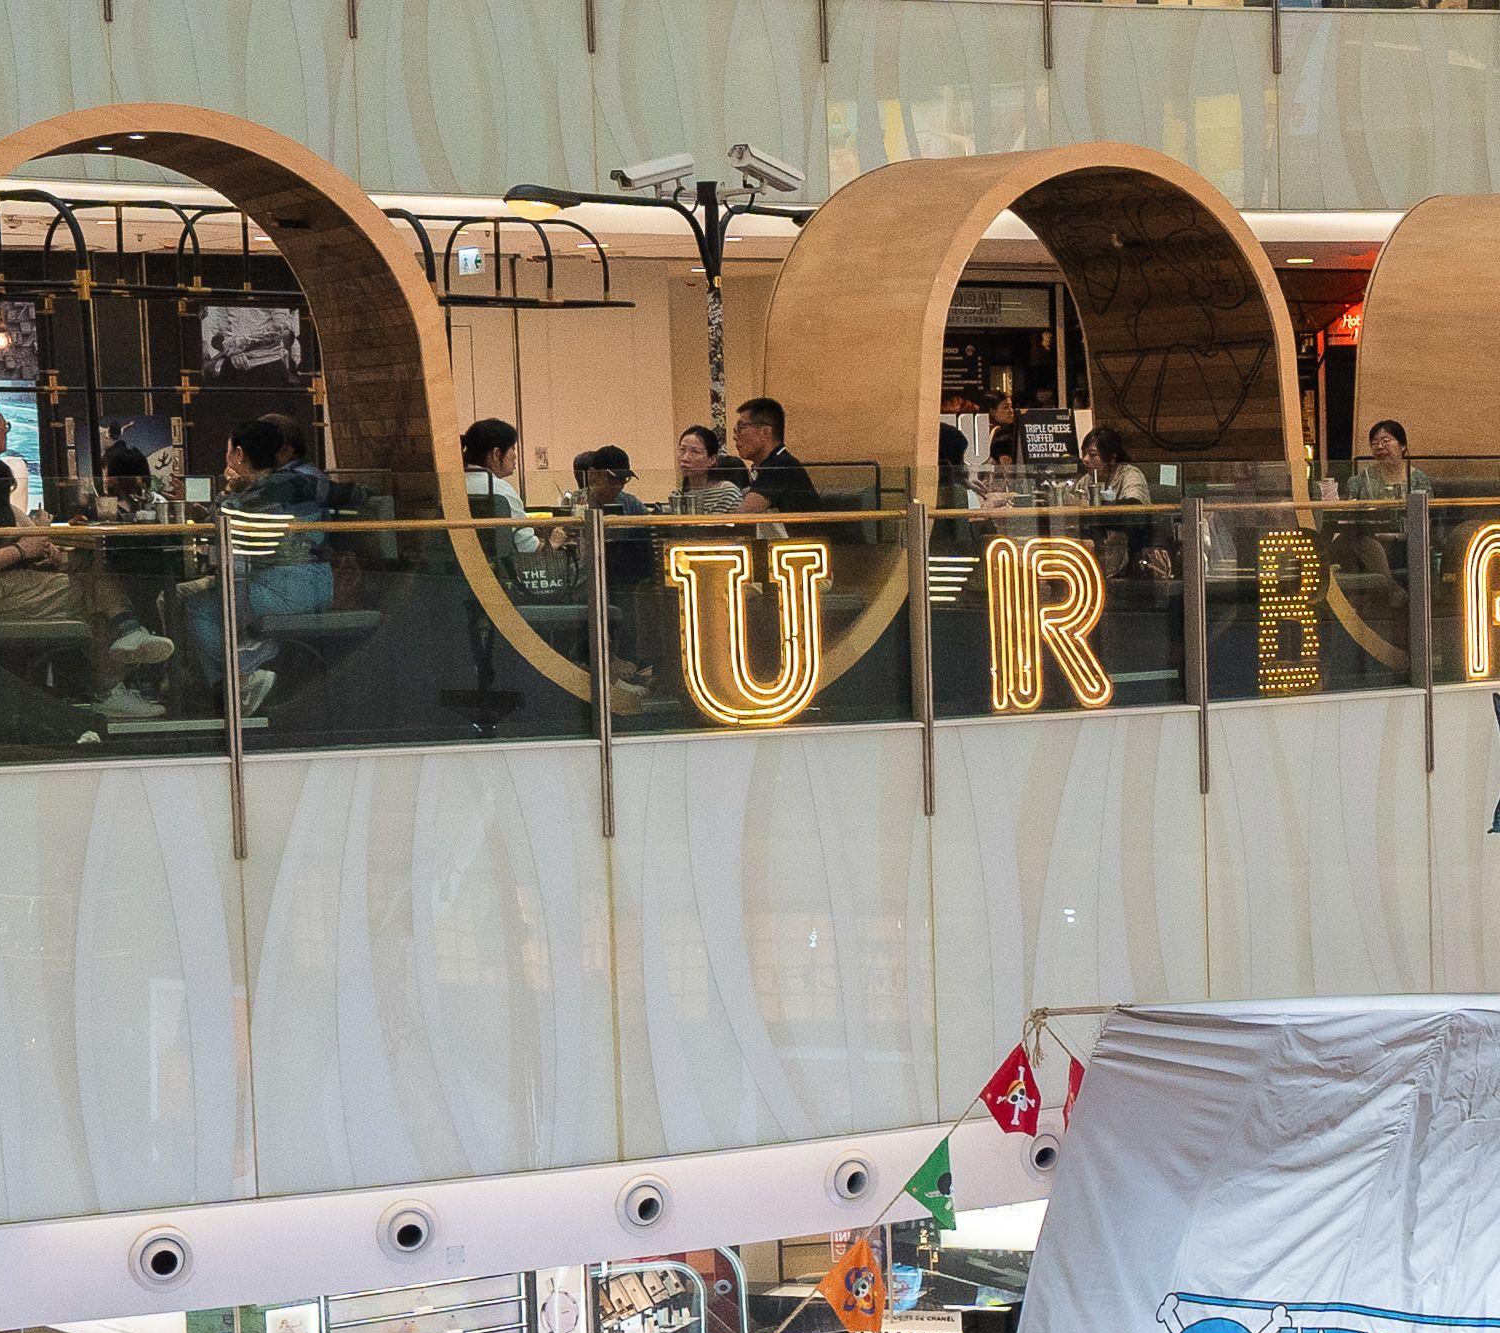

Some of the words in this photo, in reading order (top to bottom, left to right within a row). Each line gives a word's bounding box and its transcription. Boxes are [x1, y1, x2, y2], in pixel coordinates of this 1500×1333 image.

[1025, 424, 1047, 433] TRIPLE
[1048, 424, 1071, 433] CHEESE
[1026, 434, 1054, 443] STUFFED
[1028, 443, 1049, 452] CRUST
[1050, 443, 1068, 452] PIZZA
[523, 571, 546, 579] THE
